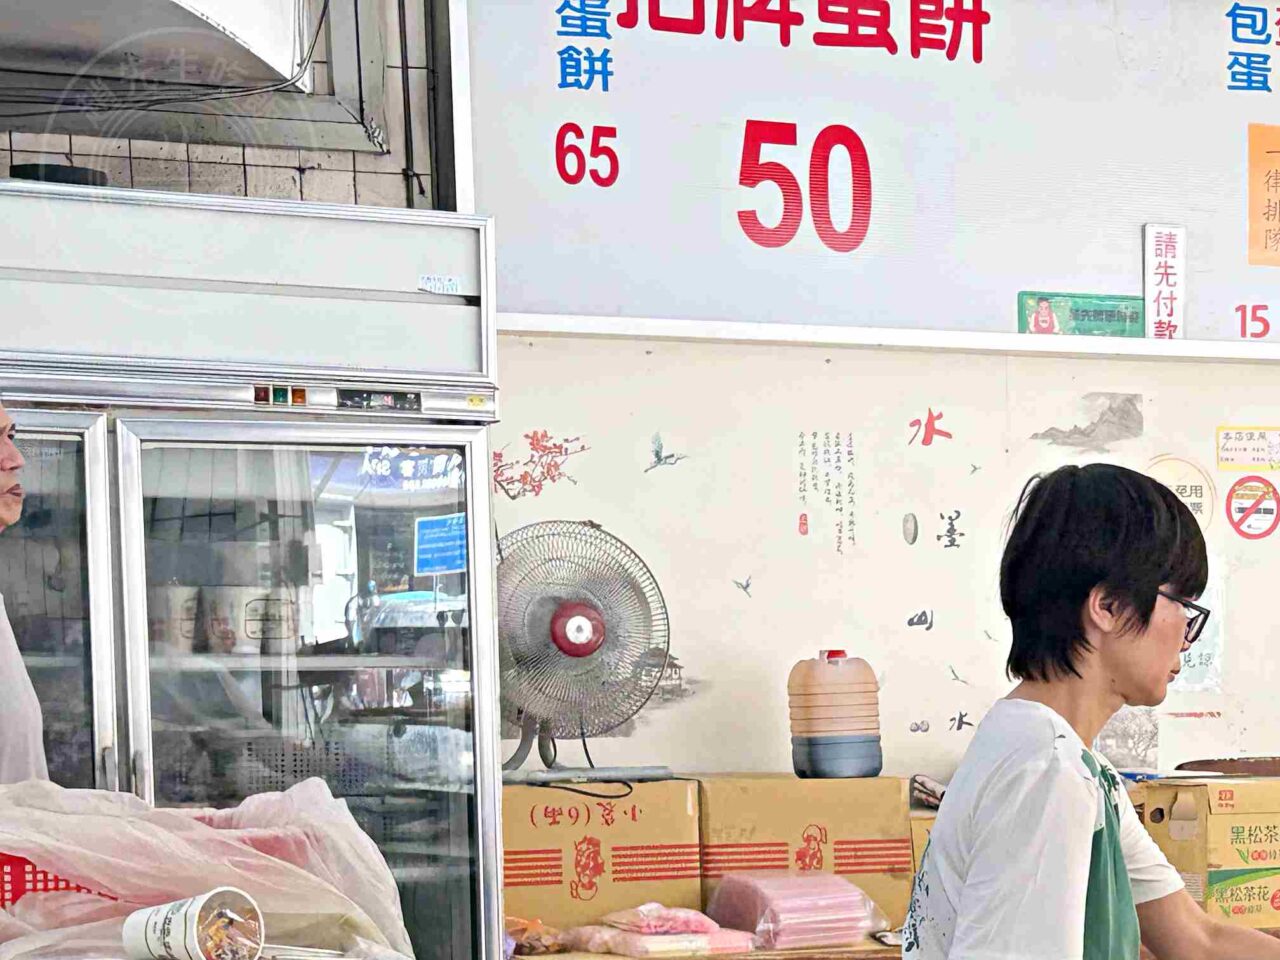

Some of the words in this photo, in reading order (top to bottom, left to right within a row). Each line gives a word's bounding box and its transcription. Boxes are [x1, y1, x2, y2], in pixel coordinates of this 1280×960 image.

[1225, 2, 1272, 92] 包蛋
[556, 122, 619, 188] 65
[737, 119, 872, 253] 50
[1153, 232, 1178, 340] 請先付款
[1235, 305, 1270, 339] 15
